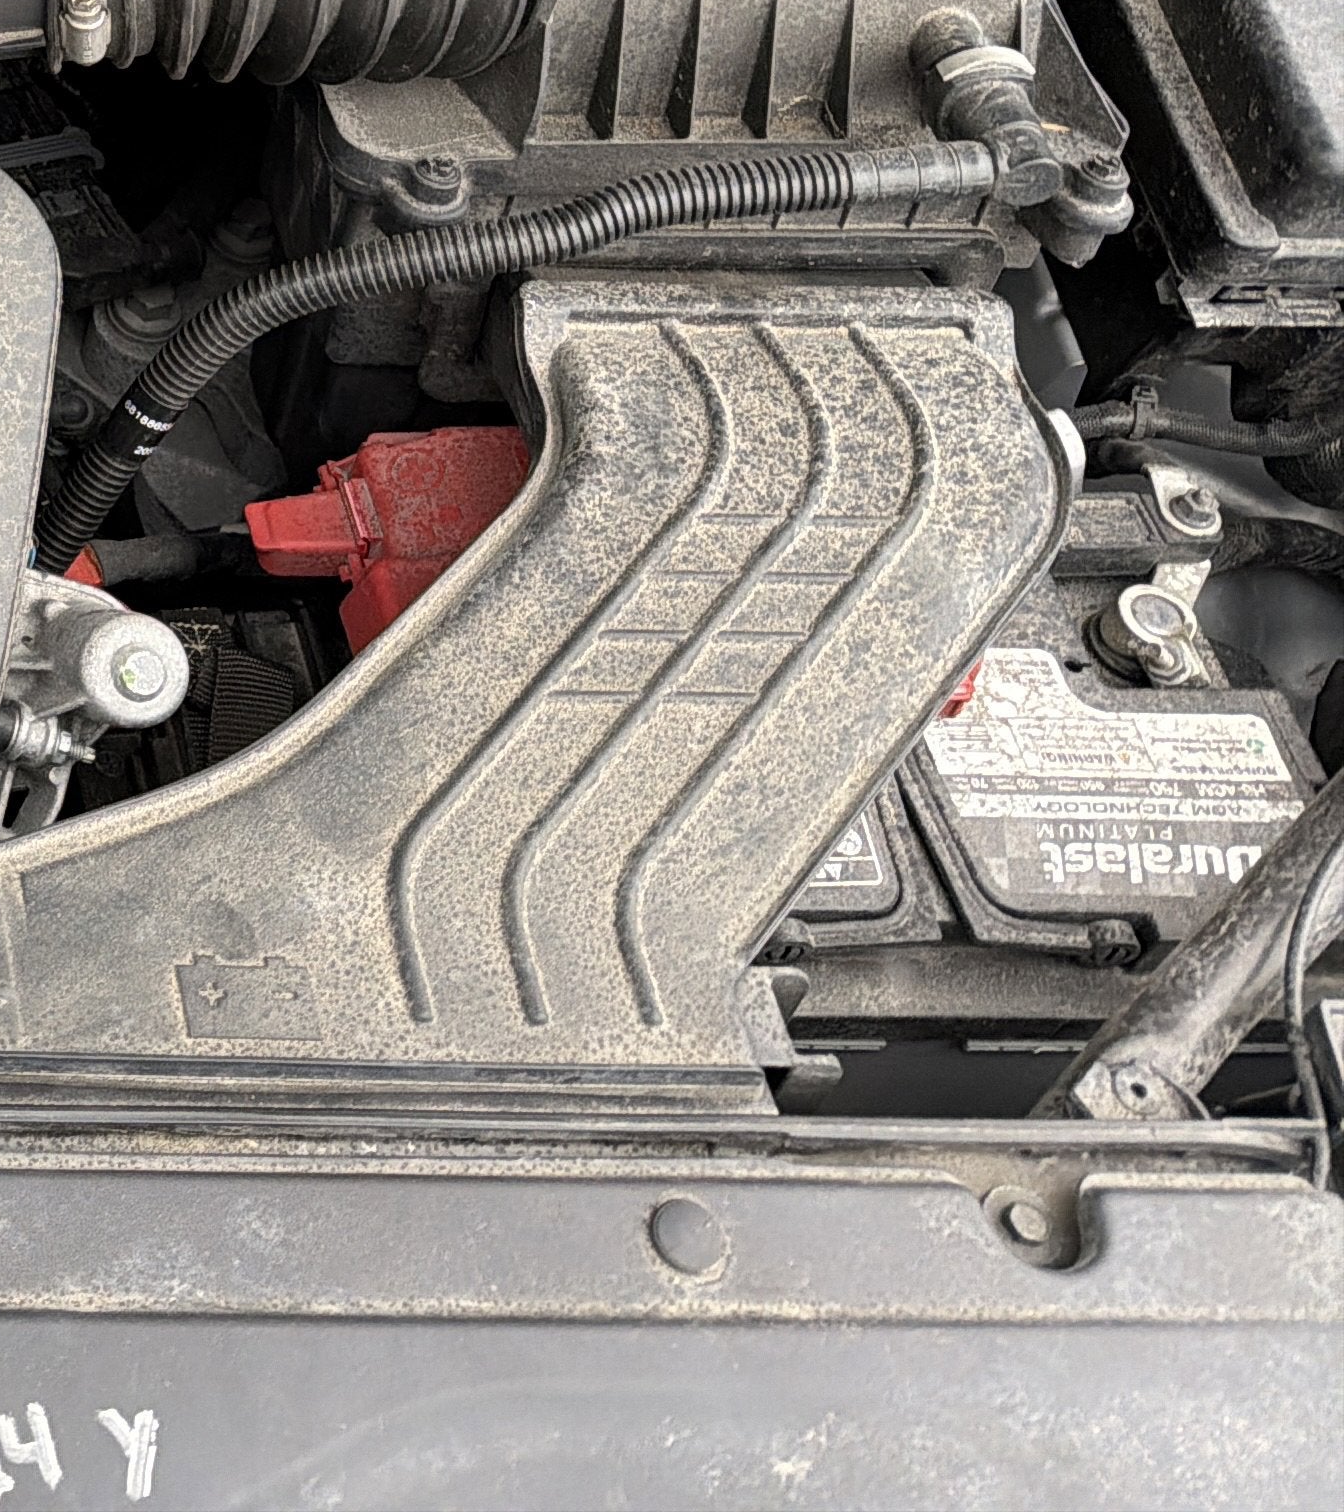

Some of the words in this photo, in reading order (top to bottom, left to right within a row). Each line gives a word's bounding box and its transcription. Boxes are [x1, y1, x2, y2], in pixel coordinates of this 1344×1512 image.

[1033, 801, 1184, 815] TECHNOLOGY
[1036, 823, 1173, 841] PLATINUM
[1040, 842, 1262, 884] Duralast
